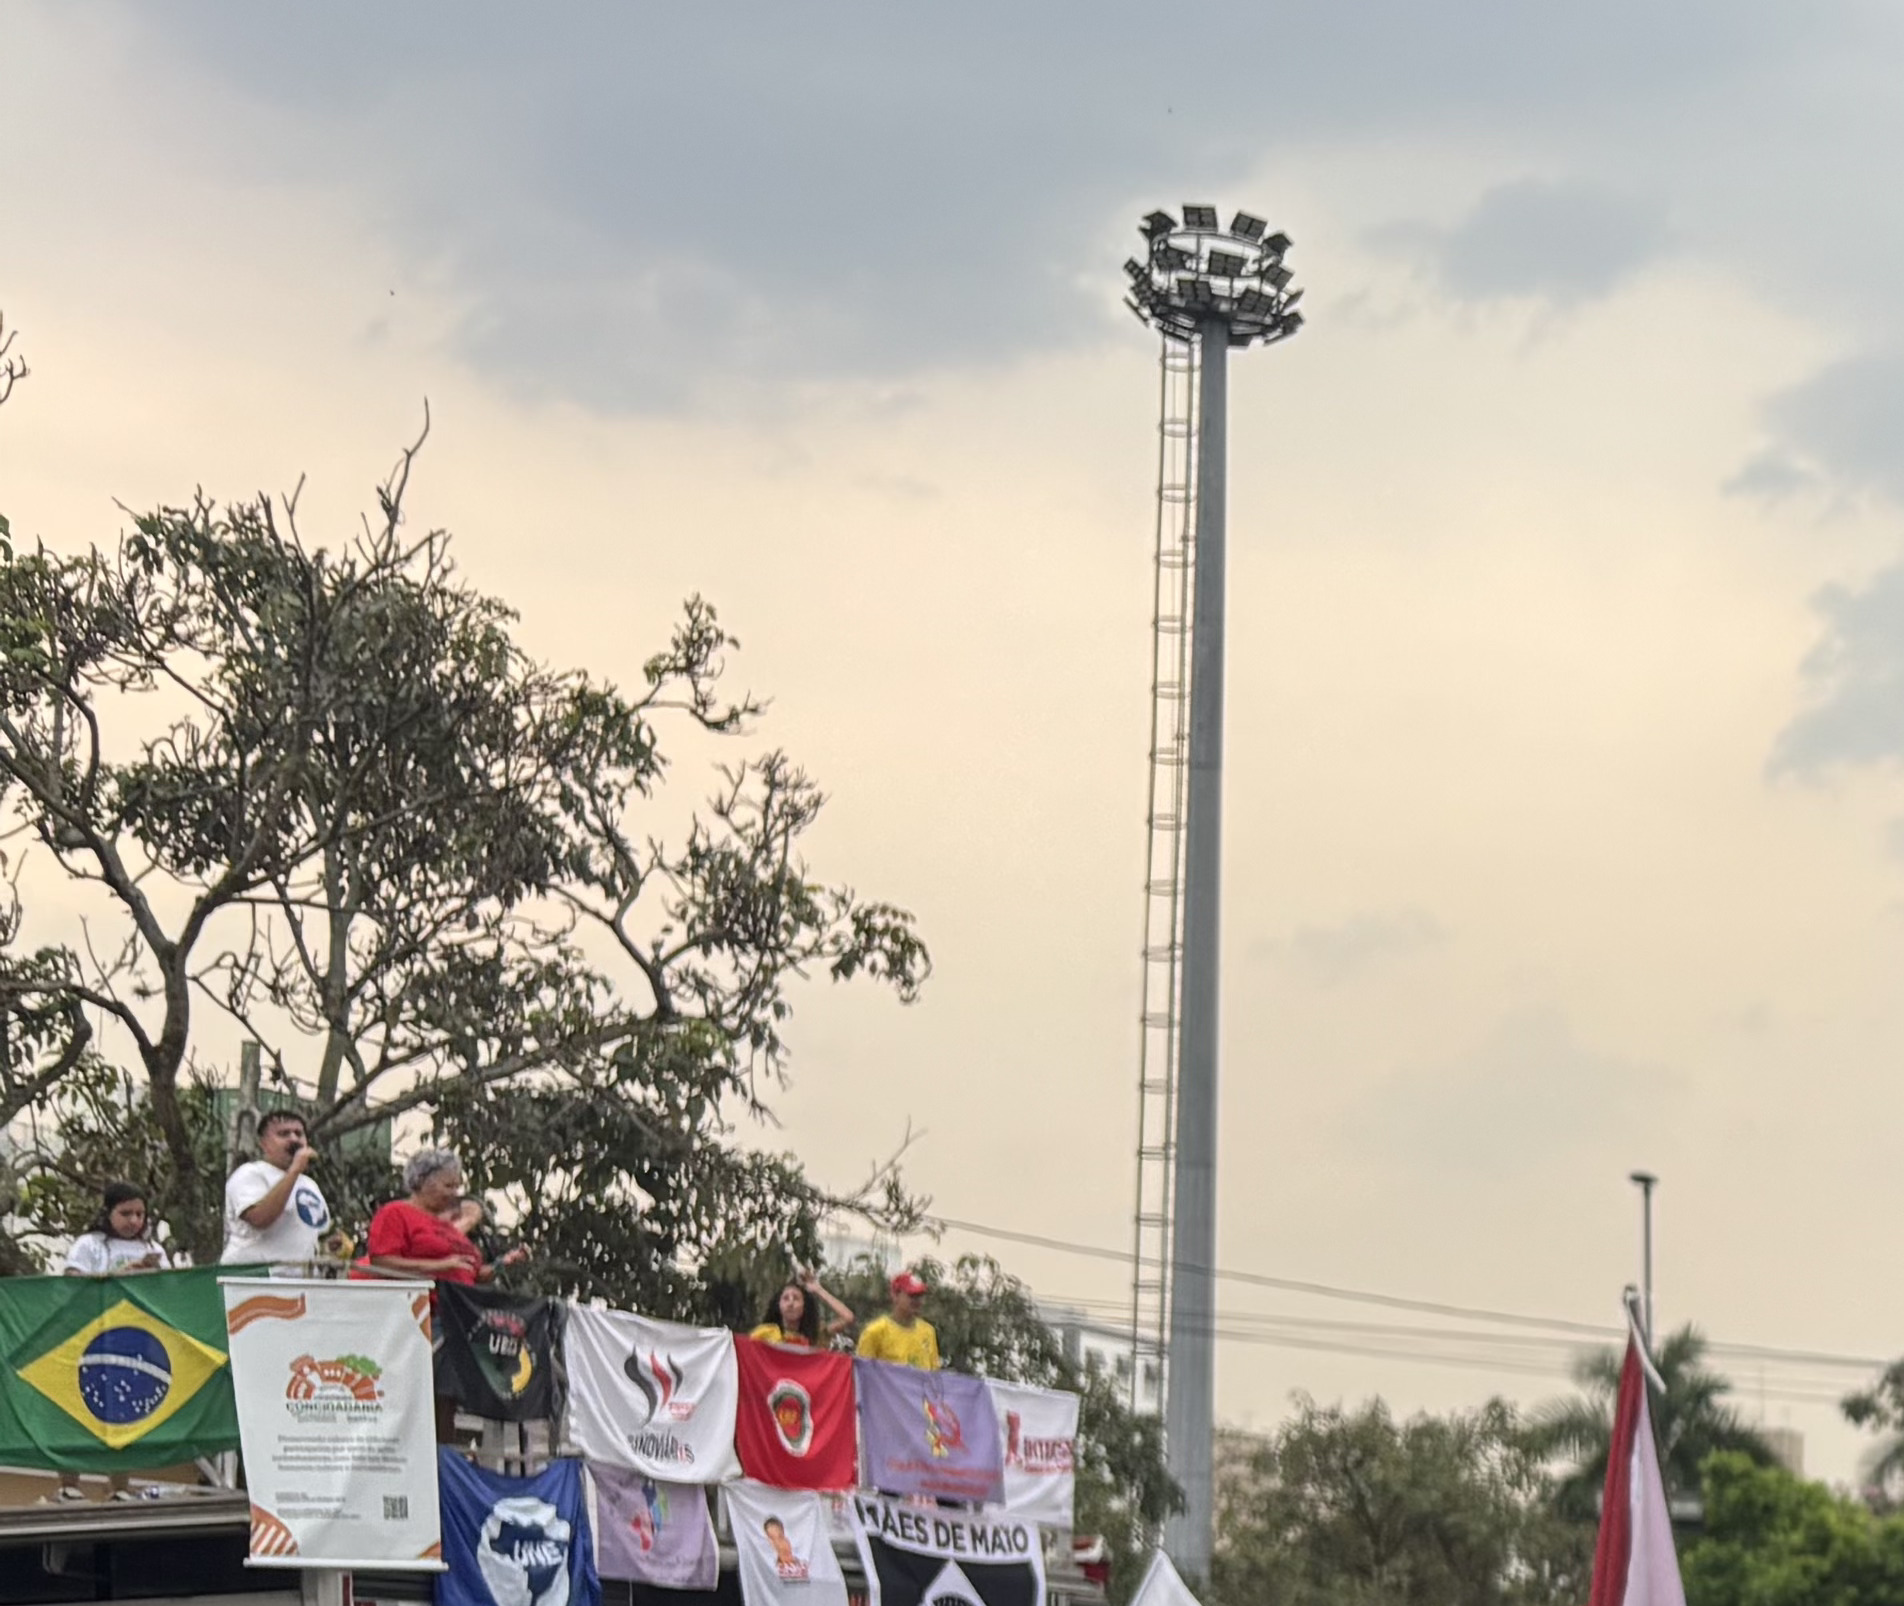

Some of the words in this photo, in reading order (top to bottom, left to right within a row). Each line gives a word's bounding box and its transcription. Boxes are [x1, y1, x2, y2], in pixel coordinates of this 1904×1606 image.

[513, 1537, 563, 1567] UNE
[934, 1522, 967, 1551] DE
[969, 1522, 1029, 1554] MAIO
